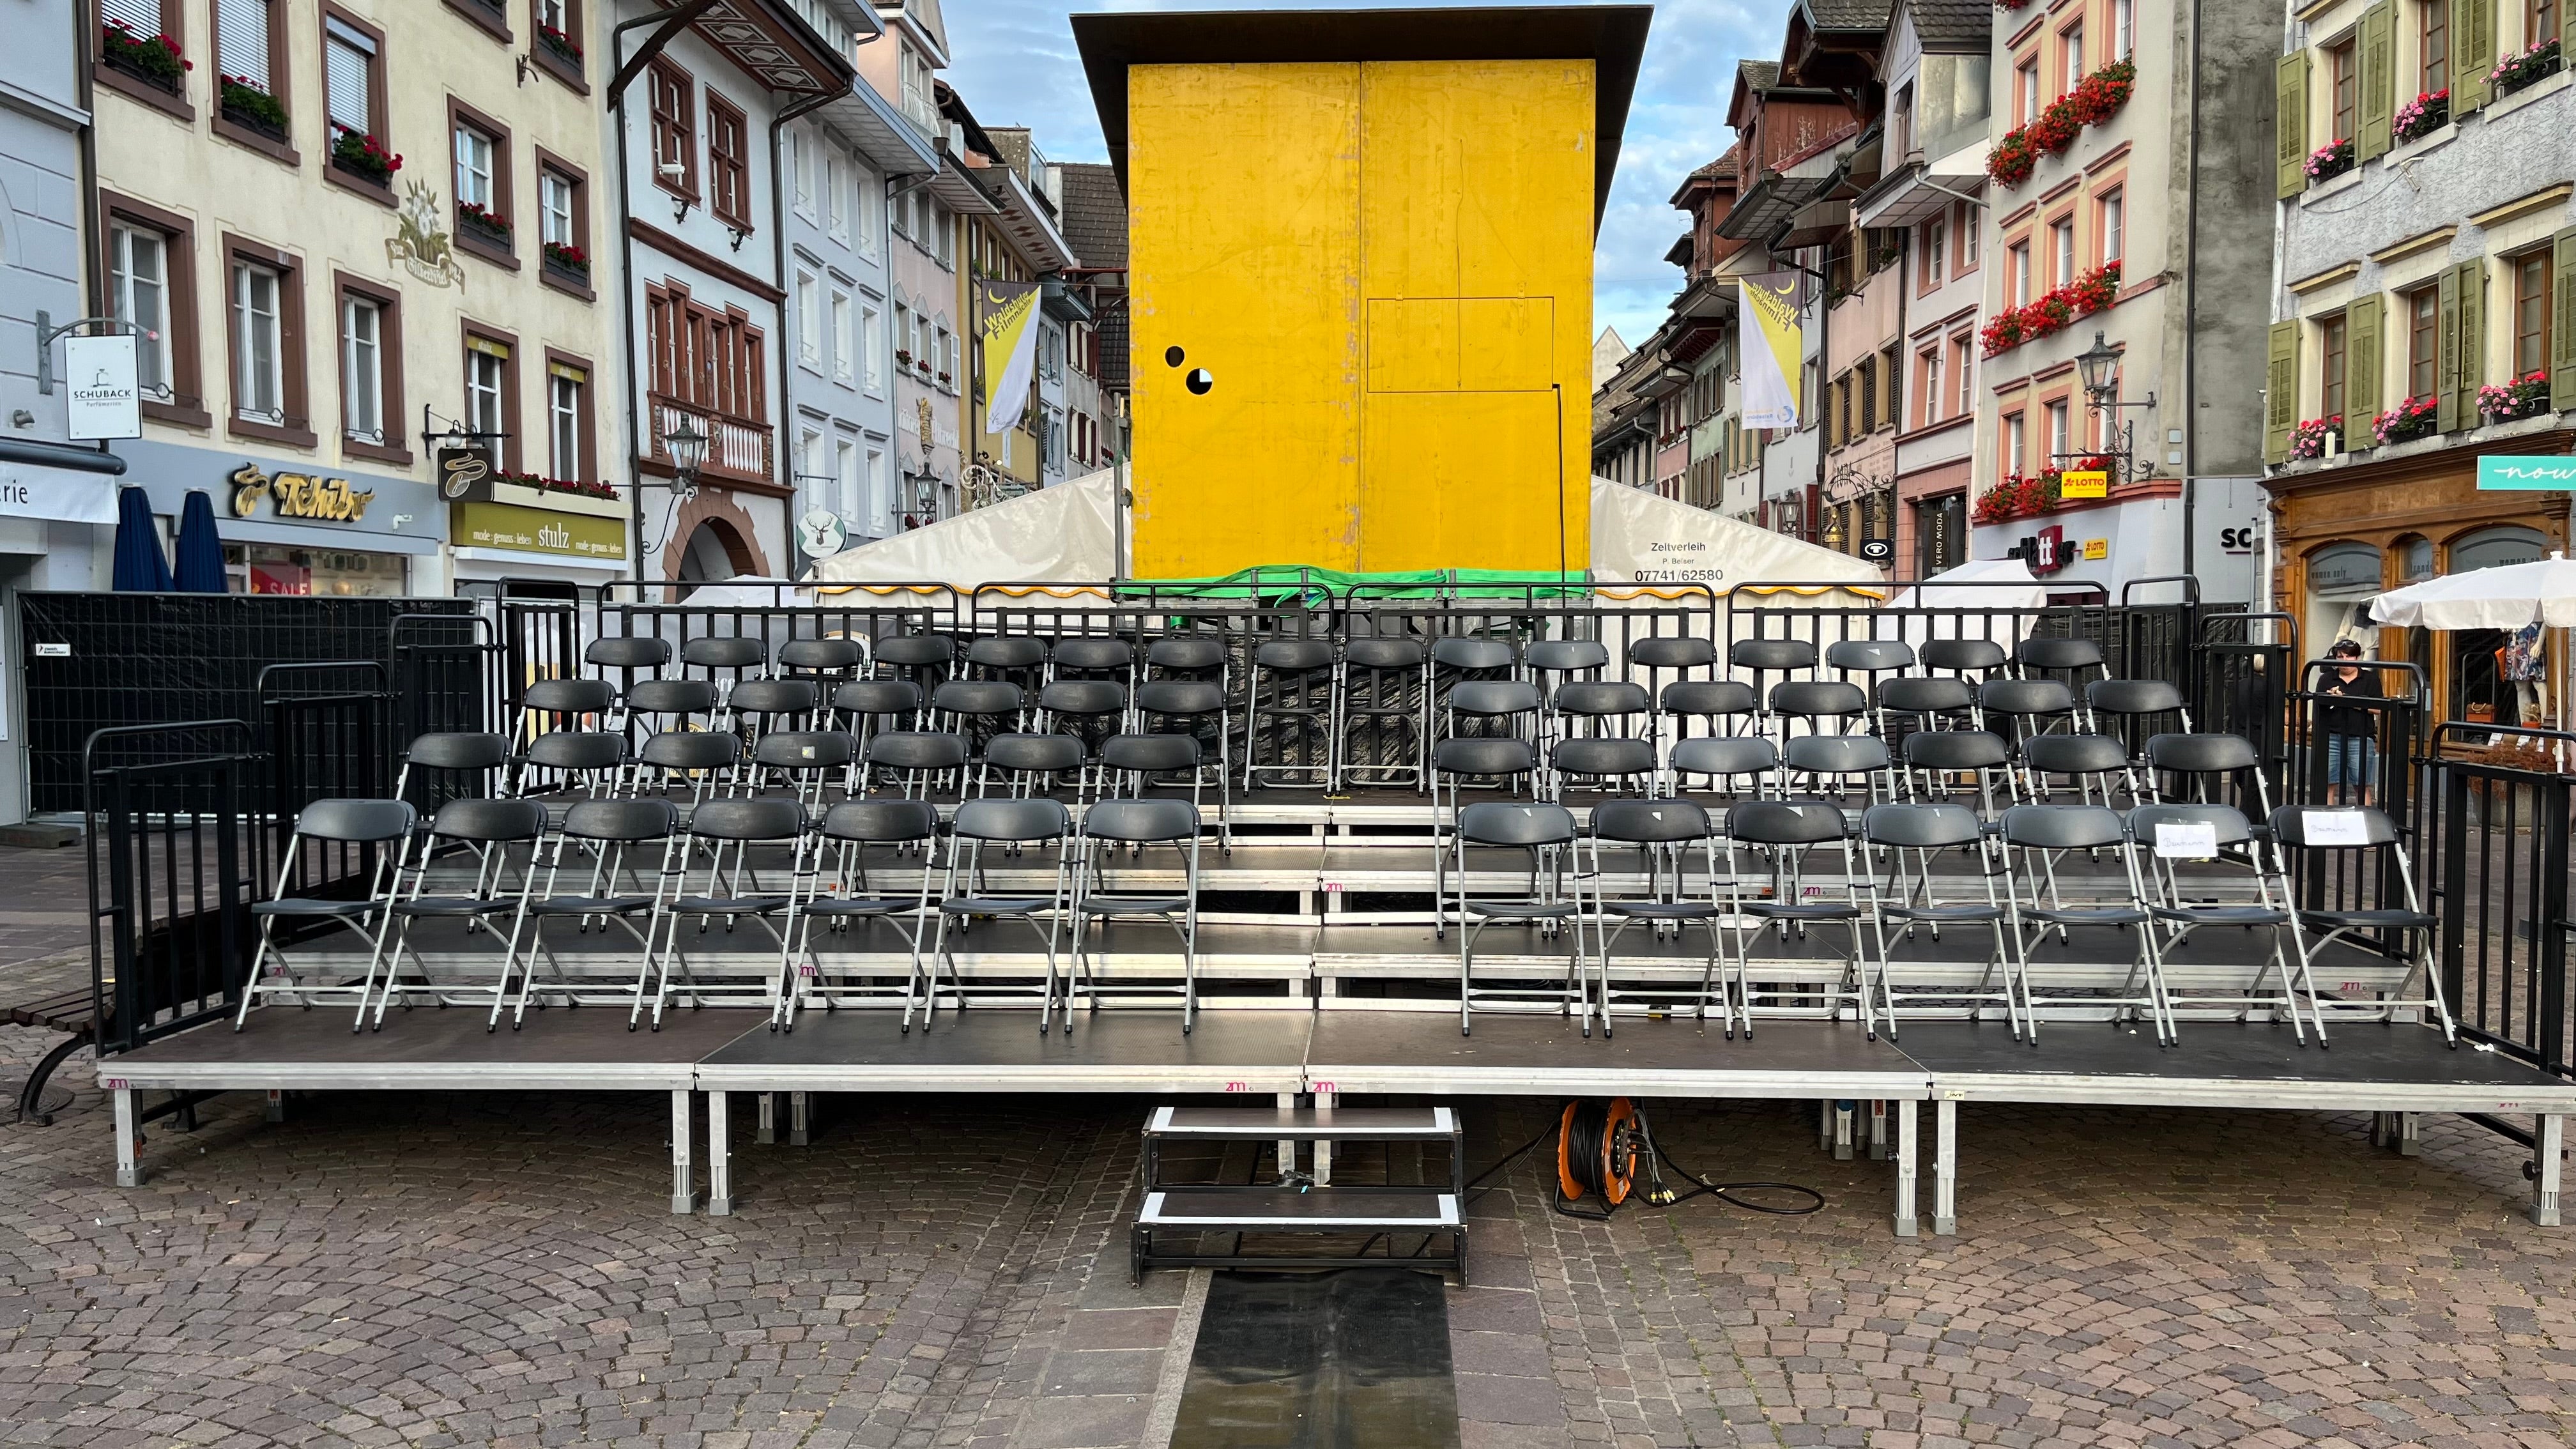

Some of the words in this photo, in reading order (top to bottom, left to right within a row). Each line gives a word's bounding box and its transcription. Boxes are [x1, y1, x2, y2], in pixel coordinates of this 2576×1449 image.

[984, 291, 1028, 331] Waldshuter
[992, 298, 1031, 341] Filmnächte
[74, 389, 131, 399] SCHUBACK
[0, 479, 27, 504] rie
[274, 471, 376, 521] Tchibo
[538, 522, 569, 549] stulz
[1651, 542, 1706, 551] Zeltverleih
[2091, 542, 2104, 551] LOTTO
[1635, 569, 1723, 582] 07741/62580
[270, 583, 309, 595] SALE
[1225, 1082, 1246, 1092] 2m
[1313, 1082, 1335, 1092] 2m
